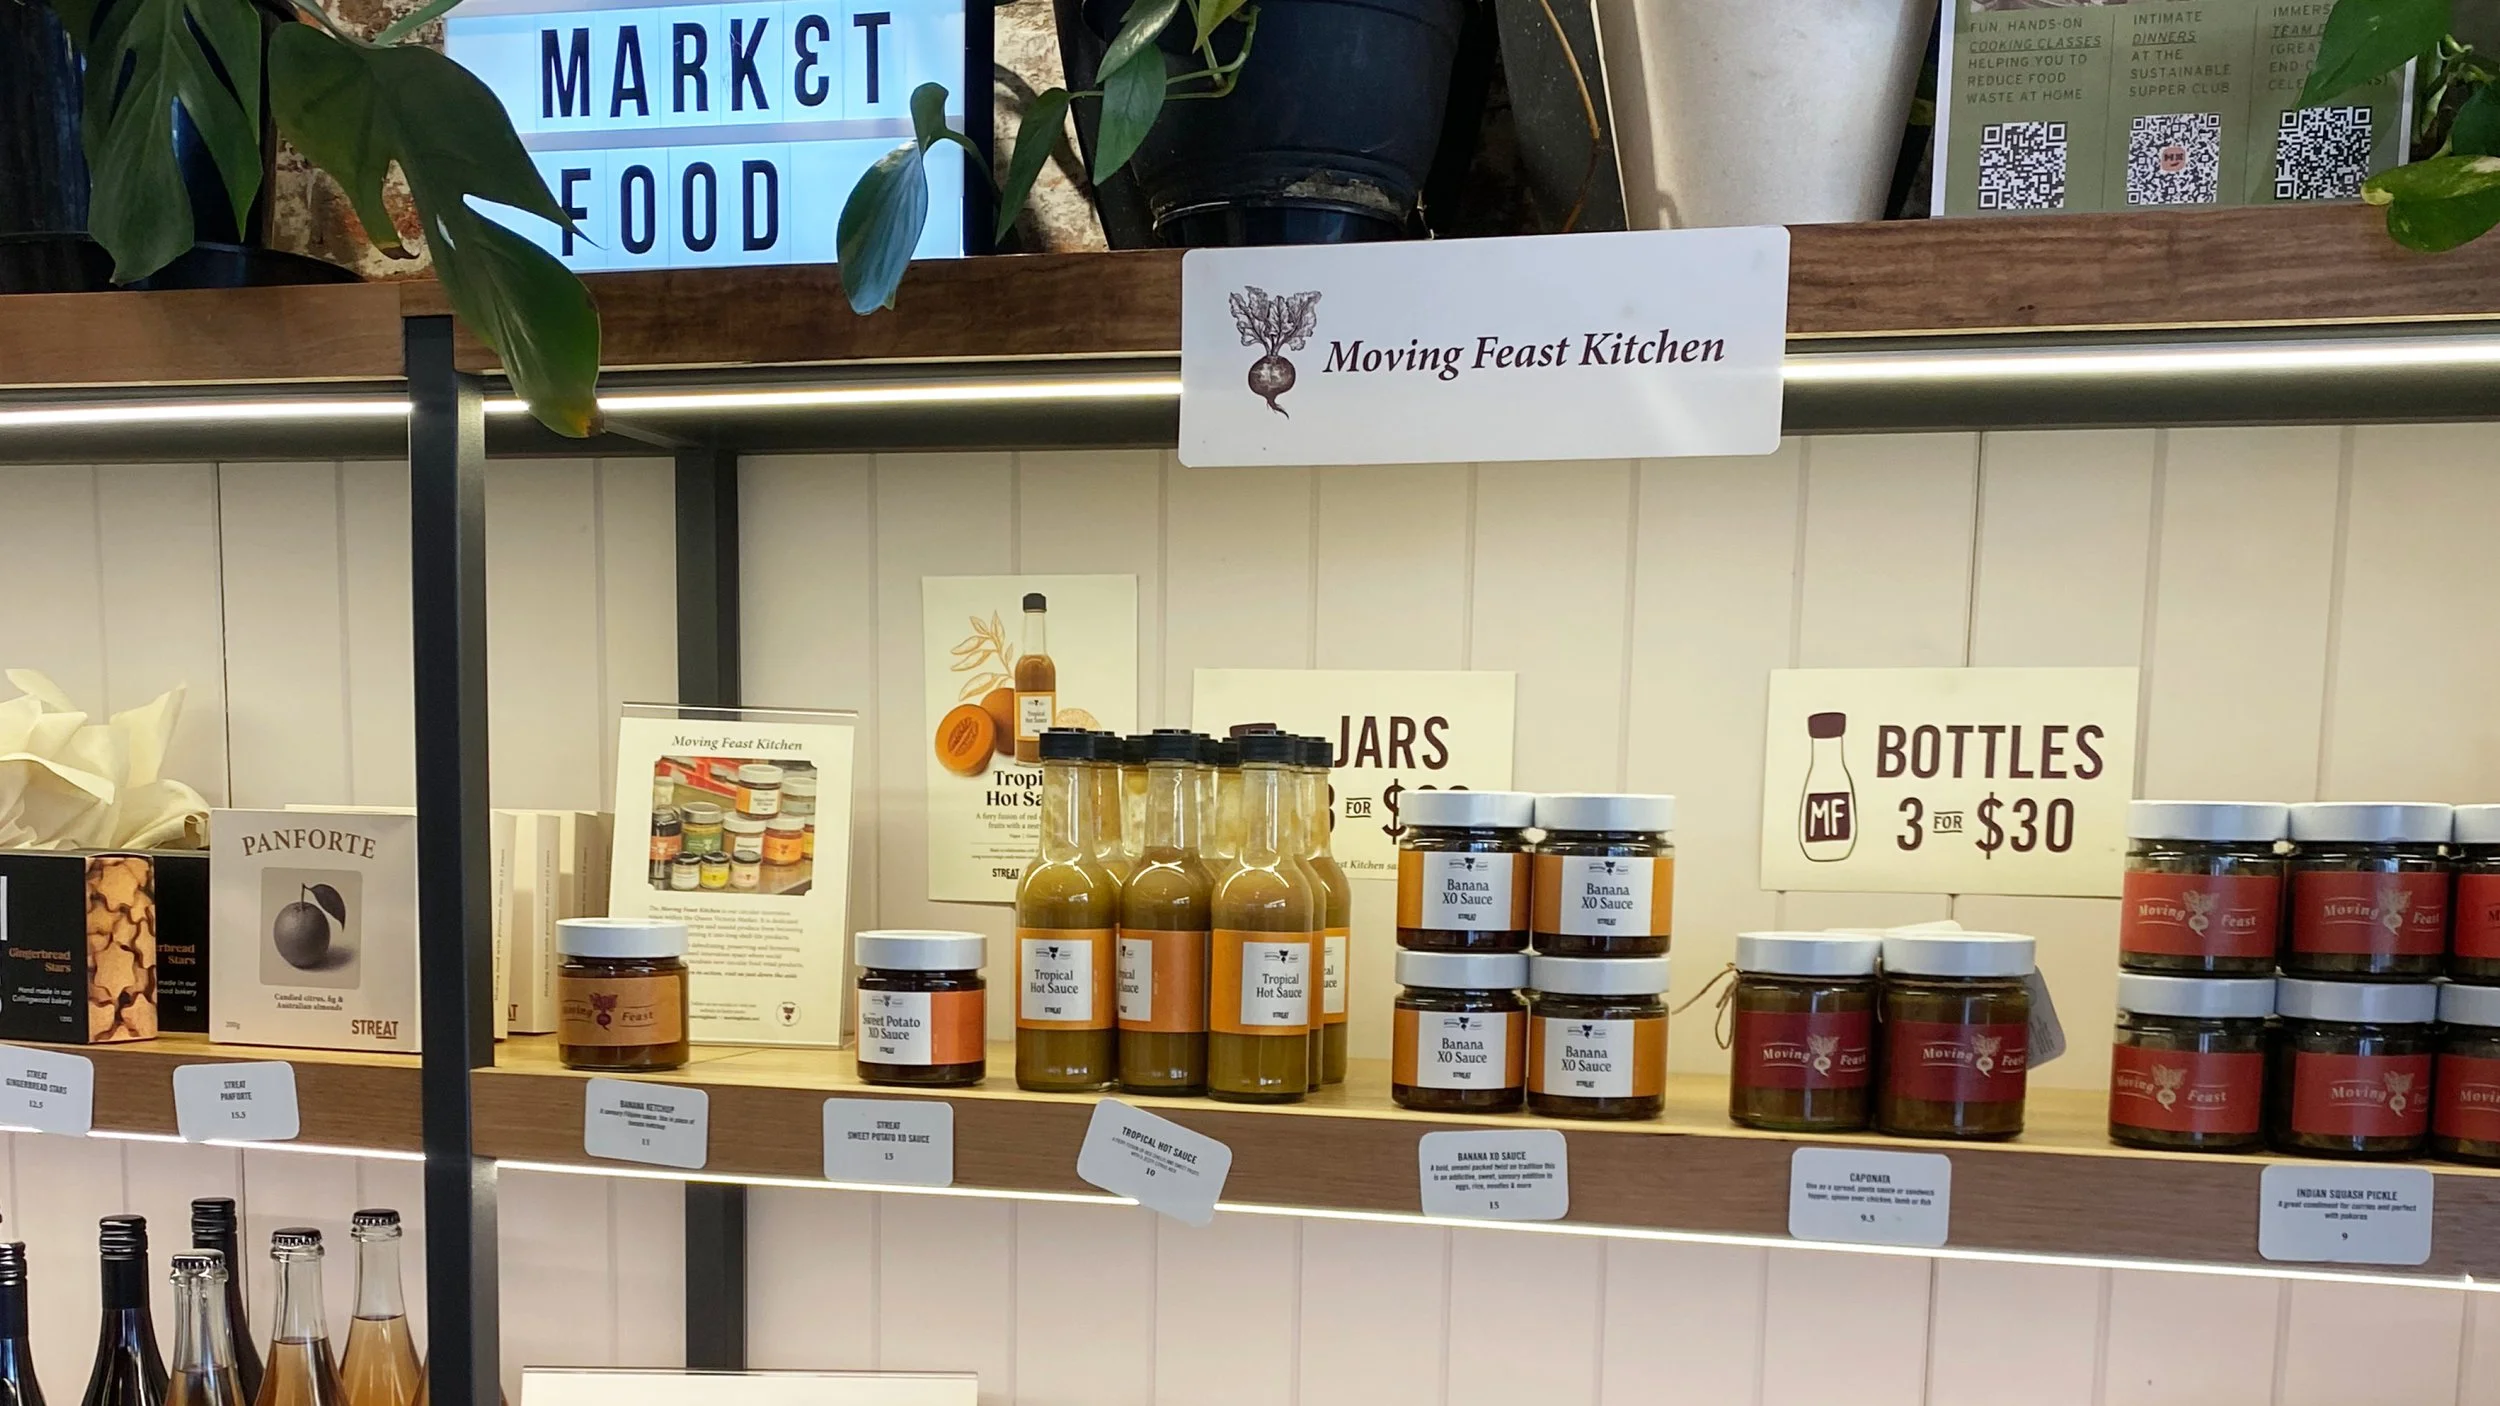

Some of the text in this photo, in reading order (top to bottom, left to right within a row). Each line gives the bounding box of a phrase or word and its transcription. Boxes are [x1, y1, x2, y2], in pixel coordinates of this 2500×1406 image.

[2133, 10, 2203, 25] INTIMATE
[2008, 17, 2083, 32] HANDS-ON
[2272, 25, 2312, 37] TEAM
[1969, 35, 2102, 52] COOKING CLASSES
[2132, 30, 2197, 46] DINNERS
[1968, 54, 2087, 69] HELPING YOU TO
[2131, 48, 2183, 62] AT THE
[2130, 64, 2232, 79] SUSTAINABLE
[1968, 72, 2066, 87] REDUCE FOOD
[2129, 82, 2230, 97] SUPPER CLUB
[1967, 89, 2082, 104] WASTE AT HOME
[560, 159, 779, 256] FOOD
[1322, 329, 1726, 381] Moving Feast Kitchen
[672, 735, 803, 751] Moving Feast Kitchen
[1334, 715, 1450, 770] JARS
[1877, 724, 2105, 780] BOTTLES
[986, 791, 1018, 806] Hot
[1345, 801, 1371, 815] FOR
[1809, 798, 1846, 838] MF
[1897, 791, 2075, 860] 3 FOR $30
[241, 828, 377, 860] PANFORTE
[1350, 860, 1385, 870] Kitchen
[992, 868, 1020, 880] STREAT
[1447, 879, 1490, 892] Banana
[1586, 883, 1630, 896] Banana
[1442, 892, 1493, 905] XO Sauce
[1581, 897, 1634, 910] XO Sauce
[2138, 903, 2186, 919] Moving
[2323, 903, 2379, 919] Moving
[2220, 913, 2257, 927] Feast
[2412, 911, 2440, 925] Feast
[9, 947, 71, 960] Gingerbread
[167, 955, 196, 966] Stars
[44, 962, 72, 973] Stars
[1034, 969, 1074, 982] Tropical
[1262, 973, 1300, 986] Tropical
[1030, 982, 1079, 995] Hot Sauce
[1256, 987, 1303, 999] Hot Sauce
[274, 993, 302, 1001] Candied
[327, 995, 336, 1003] fig
[276, 1002, 343, 1011] Australian almonds
[622, 1011, 654, 1022] Feast
[886, 1015, 921, 1029] Potato
[352, 1019, 399, 1038] STREAT
[881, 1027, 910, 1041] Sauce
[1441, 1037, 1484, 1050] Banana
[1437, 1050, 1487, 1064] XO Sauce
[1565, 1046, 1608, 1059] Banana
[1762, 1047, 1811, 1064] Moving
[1922, 1047, 1974, 1063] Moving
[1561, 1058, 1612, 1072] XO Sauce
[1839, 1053, 1867, 1066] Feast
[26, 1069, 48, 1080] STREAT
[5, 1078, 67, 1095] GINGERBREAD STARS
[224, 1080, 246, 1090] STREAT
[2116, 1075, 2155, 1095] Moving
[220, 1091, 252, 1102] PANFORTE
[2187, 1089, 2227, 1103] Feast
[2331, 1086, 2387, 1101] Moving
[29, 1100, 43, 1109] 12.5
[231, 1111, 246, 1120] 15.5
[876, 1121, 901, 1130] STREAT
[847, 1131, 930, 1144] SWEET POTATO XO SAUCE
[1122, 1126, 1198, 1165] TROPICAL HOT SAUCE
[884, 1152, 894, 1161] 15
[1457, 1151, 1527, 1161] BANANA XO SAUCE
[1145, 1167, 1156, 1177] 10
[1472, 1163, 1493, 1172] packed
[1849, 1173, 1891, 1184] CAPONATA
[1455, 1183, 1471, 1191] eggs,
[2297, 1188, 2398, 1201] INDIAN SQUASH PICKLE
[1489, 1201, 1500, 1210] 15
[1860, 1214, 1876, 1223] 9.5
[2324, 1212, 2339, 1220] with
[2341, 1232, 2348, 1240] 9
